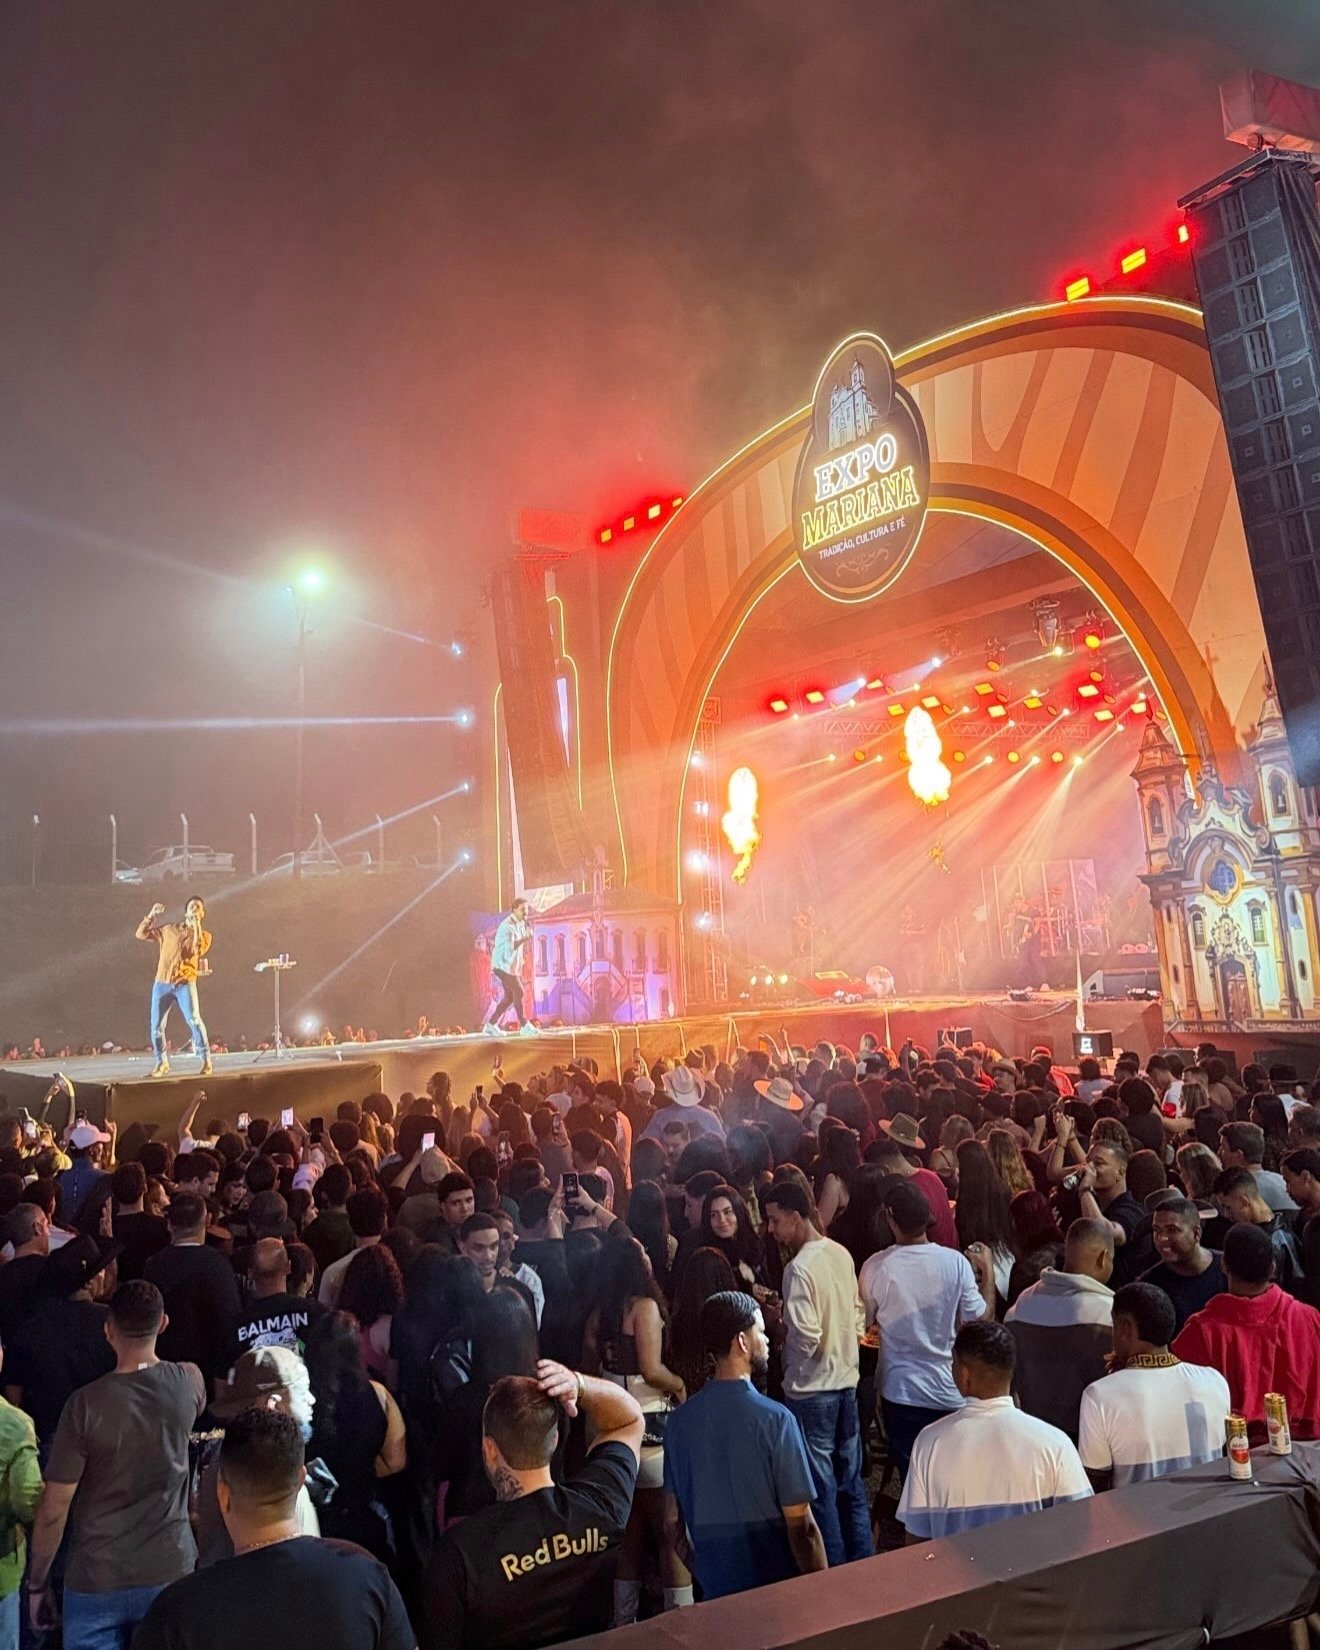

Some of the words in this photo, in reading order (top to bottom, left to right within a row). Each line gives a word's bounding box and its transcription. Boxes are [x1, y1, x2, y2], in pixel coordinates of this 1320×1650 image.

[813, 432, 897, 502] EXPO
[801, 465, 920, 550] MARIANA
[856, 524, 889, 545] CULTURA
[889, 521, 896, 532] E
[896, 514, 906, 530] FÉ
[238, 1312, 308, 1341] BALMAIN
[500, 1537, 551, 1582] Red
[552, 1527, 609, 1560] Bulls
